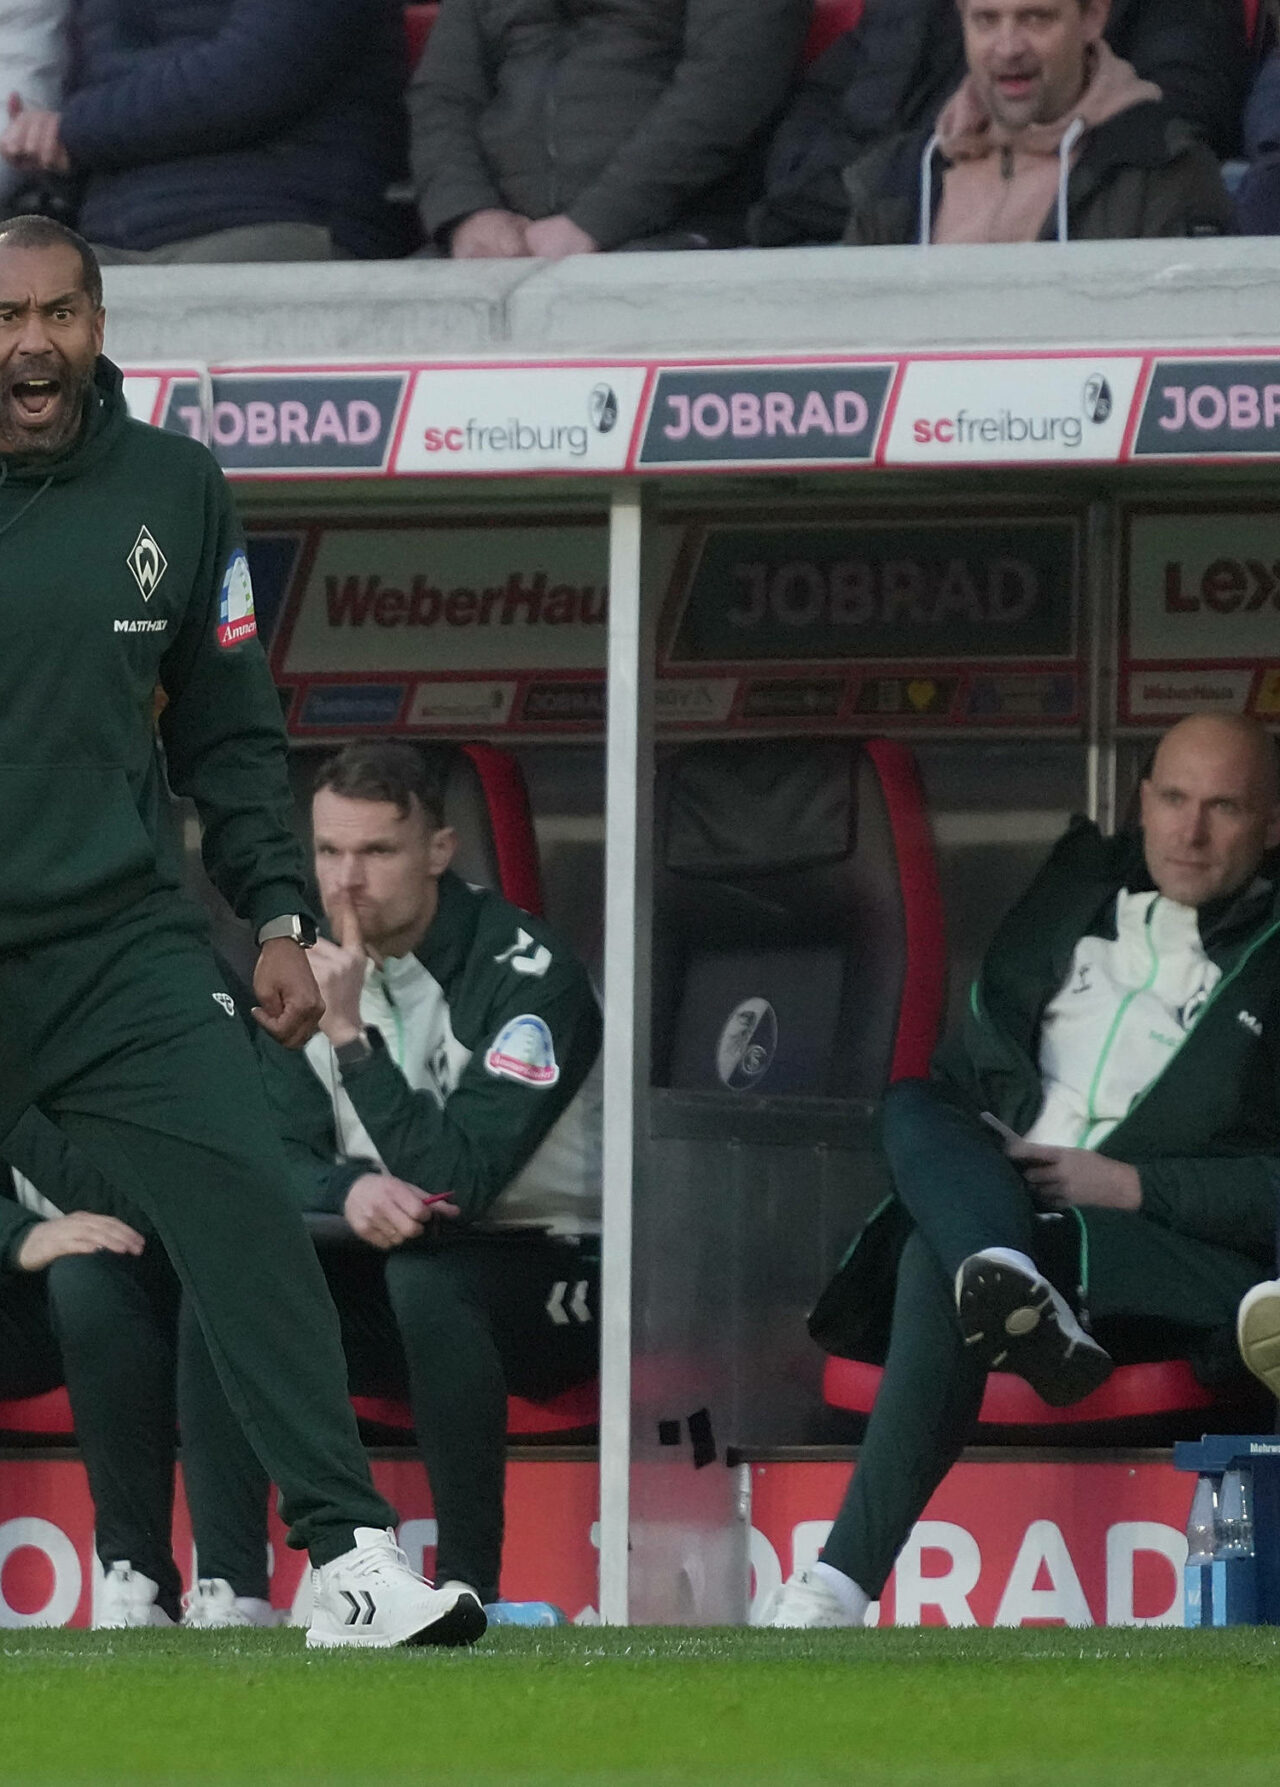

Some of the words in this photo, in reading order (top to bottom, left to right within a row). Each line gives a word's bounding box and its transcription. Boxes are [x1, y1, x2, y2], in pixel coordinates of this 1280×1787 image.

[177, 400, 382, 447] JOBRAD
[424, 418, 588, 456] scfreiburg
[664, 390, 869, 439] JOBRAD
[913, 409, 1083, 447] scfreiburg
[728, 558, 1040, 626] JOBRAD
